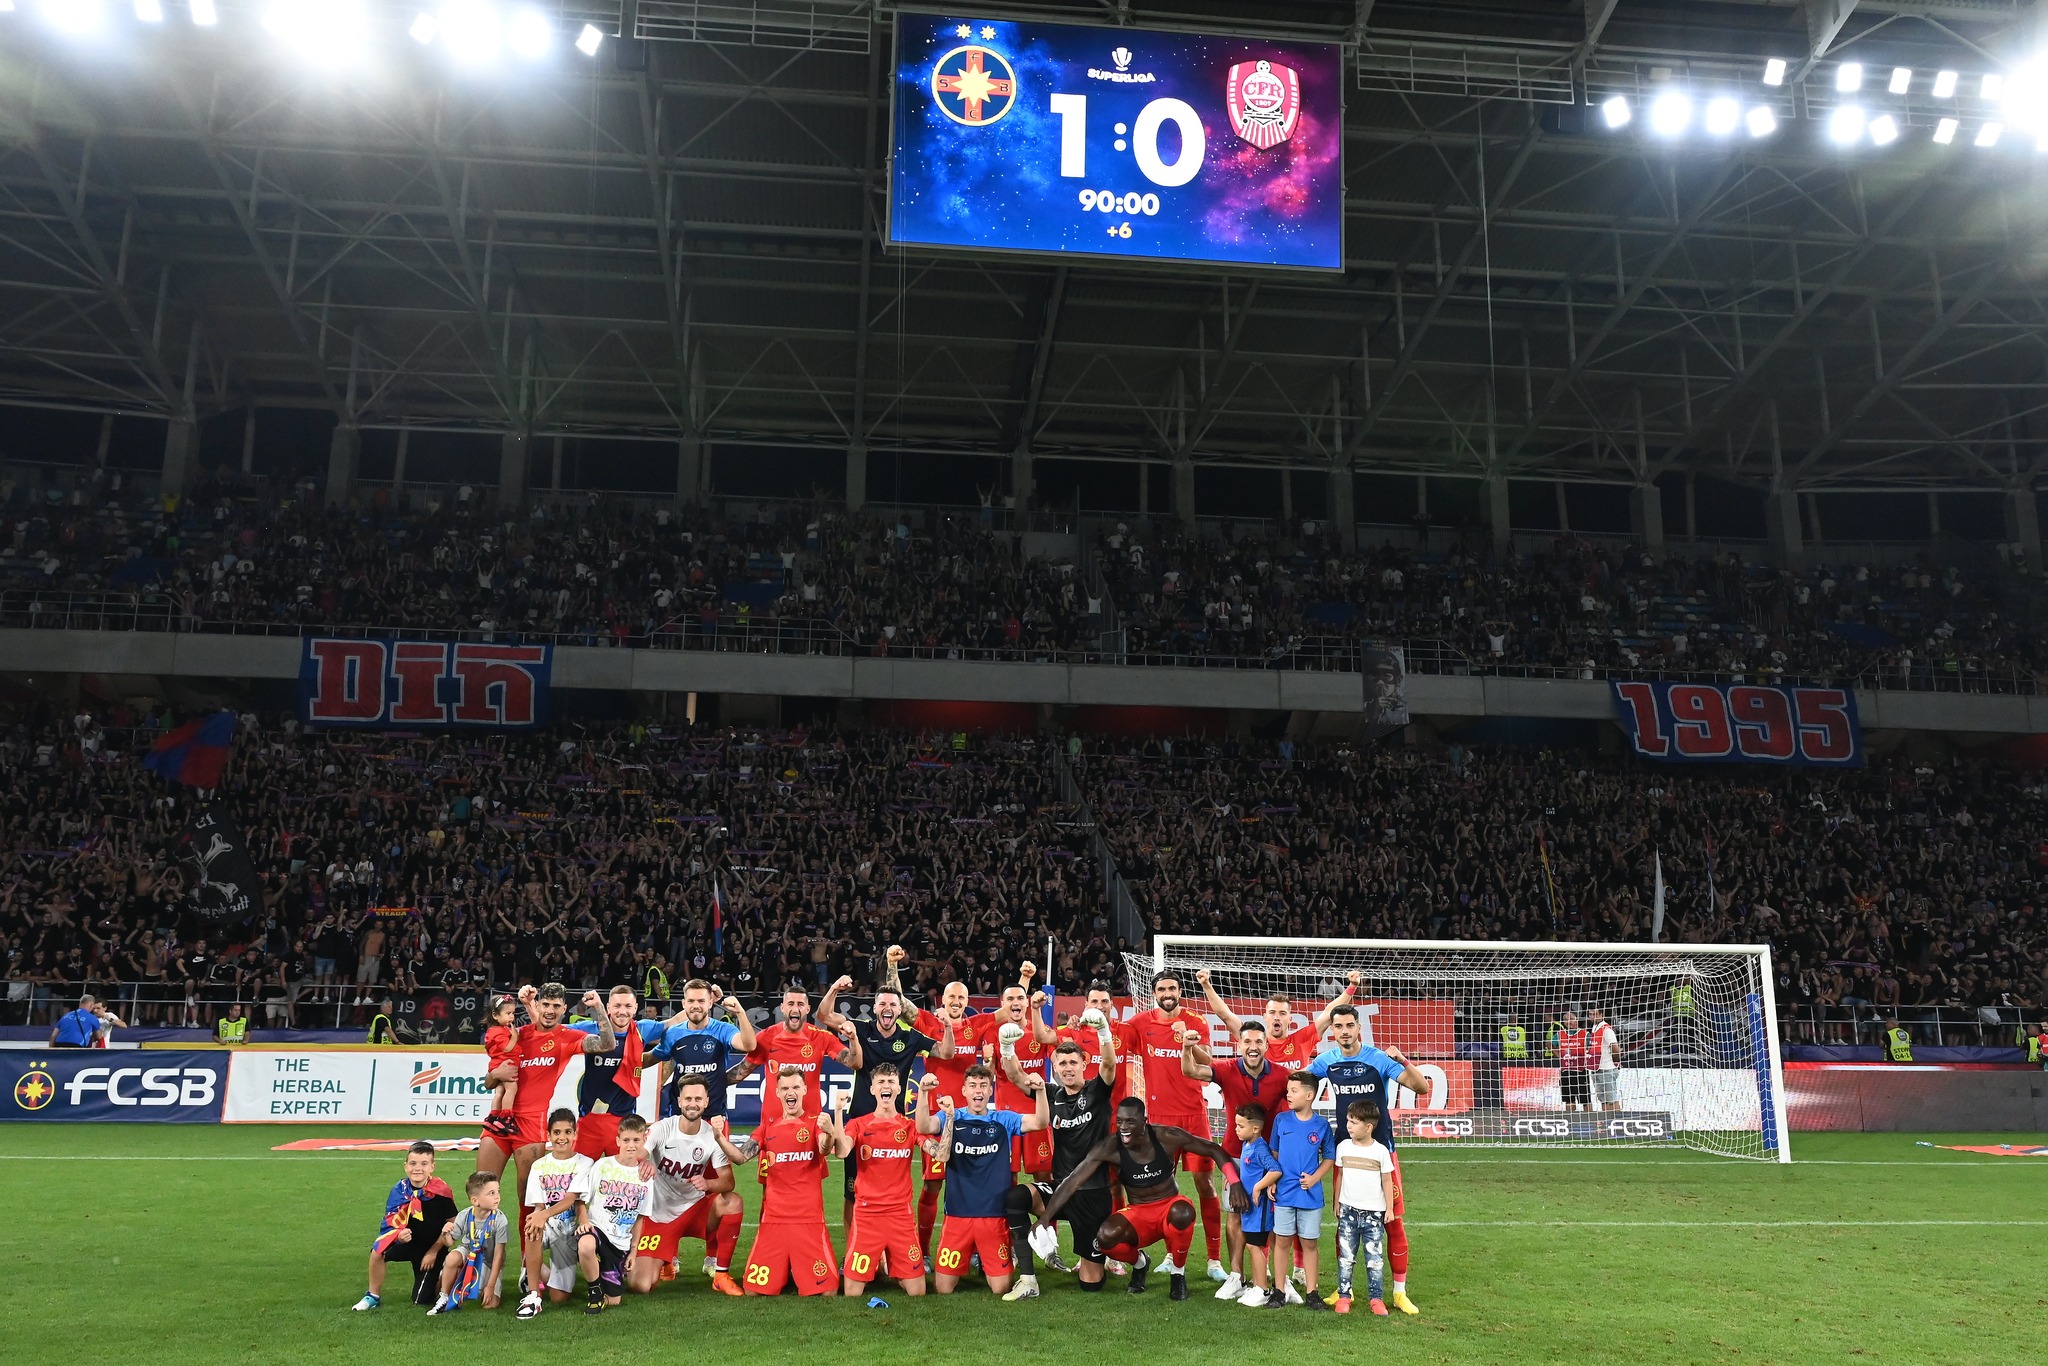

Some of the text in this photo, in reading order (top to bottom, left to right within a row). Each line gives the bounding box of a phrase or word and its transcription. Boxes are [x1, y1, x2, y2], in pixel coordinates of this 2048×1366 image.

[1242, 81, 1286, 99] CFR
[1078, 189, 1160, 216] 90:00
[1106, 223, 1132, 239] +6
[1616, 681, 1855, 762] 1995
[397, 1000, 416, 1013] 19
[453, 996, 476, 1011] 96
[693, 1043, 699, 1051] 6
[1154, 1048, 1182, 1058] BETAN
[274, 1058, 310, 1072] THE
[604, 1057, 622, 1067] BET
[1091, 1055, 1124, 1064] BENO
[684, 1062, 724, 1077] BETANO
[1343, 1068, 1352, 1076] 22
[410, 1061, 496, 1095] Hima
[64, 1067, 217, 1106] FCSB
[272, 1080, 346, 1093] HERBAL
[1339, 1083, 1376, 1095] BETANO
[270, 1100, 342, 1115] EXPERT
[410, 1104, 481, 1117] SINCE
[972, 1127, 981, 1135] 80
[1415, 1118, 1473, 1136] FCSB
[1513, 1118, 1570, 1136] FCSB
[1607, 1119, 1665, 1137] FCSB
[775, 1149, 815, 1165] BETANO
[871, 1147, 912, 1161] BETANO
[964, 1143, 999, 1158] BETANO
[657, 1156, 703, 1181] RMB
[1132, 1169, 1163, 1180] CATAPULT
[637, 1234, 661, 1252] 88
[852, 1251, 871, 1274] 10
[938, 1247, 962, 1272] 80
[746, 1263, 770, 1285] 28
